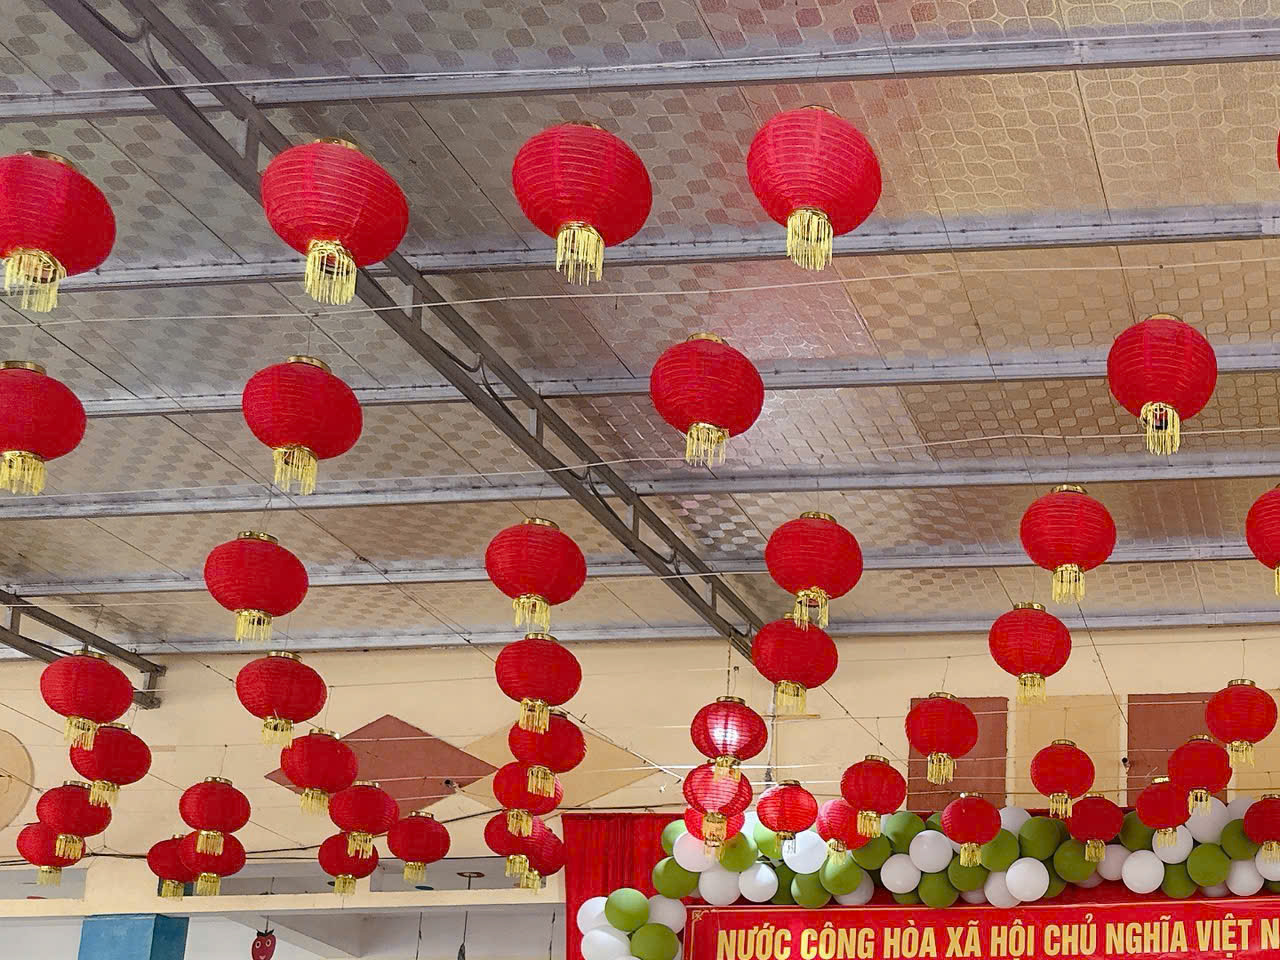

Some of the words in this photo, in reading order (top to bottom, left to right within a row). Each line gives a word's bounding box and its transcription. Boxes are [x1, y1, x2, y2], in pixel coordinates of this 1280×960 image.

[716, 922, 791, 960] NƯỚC
[883, 919, 937, 959] HÒA
[946, 920, 982, 957] XÃ
[1044, 914, 1097, 956] CHỦ
[1105, 915, 1188, 955] NGHĨA
[1195, 912, 1253, 958] VIỆT
